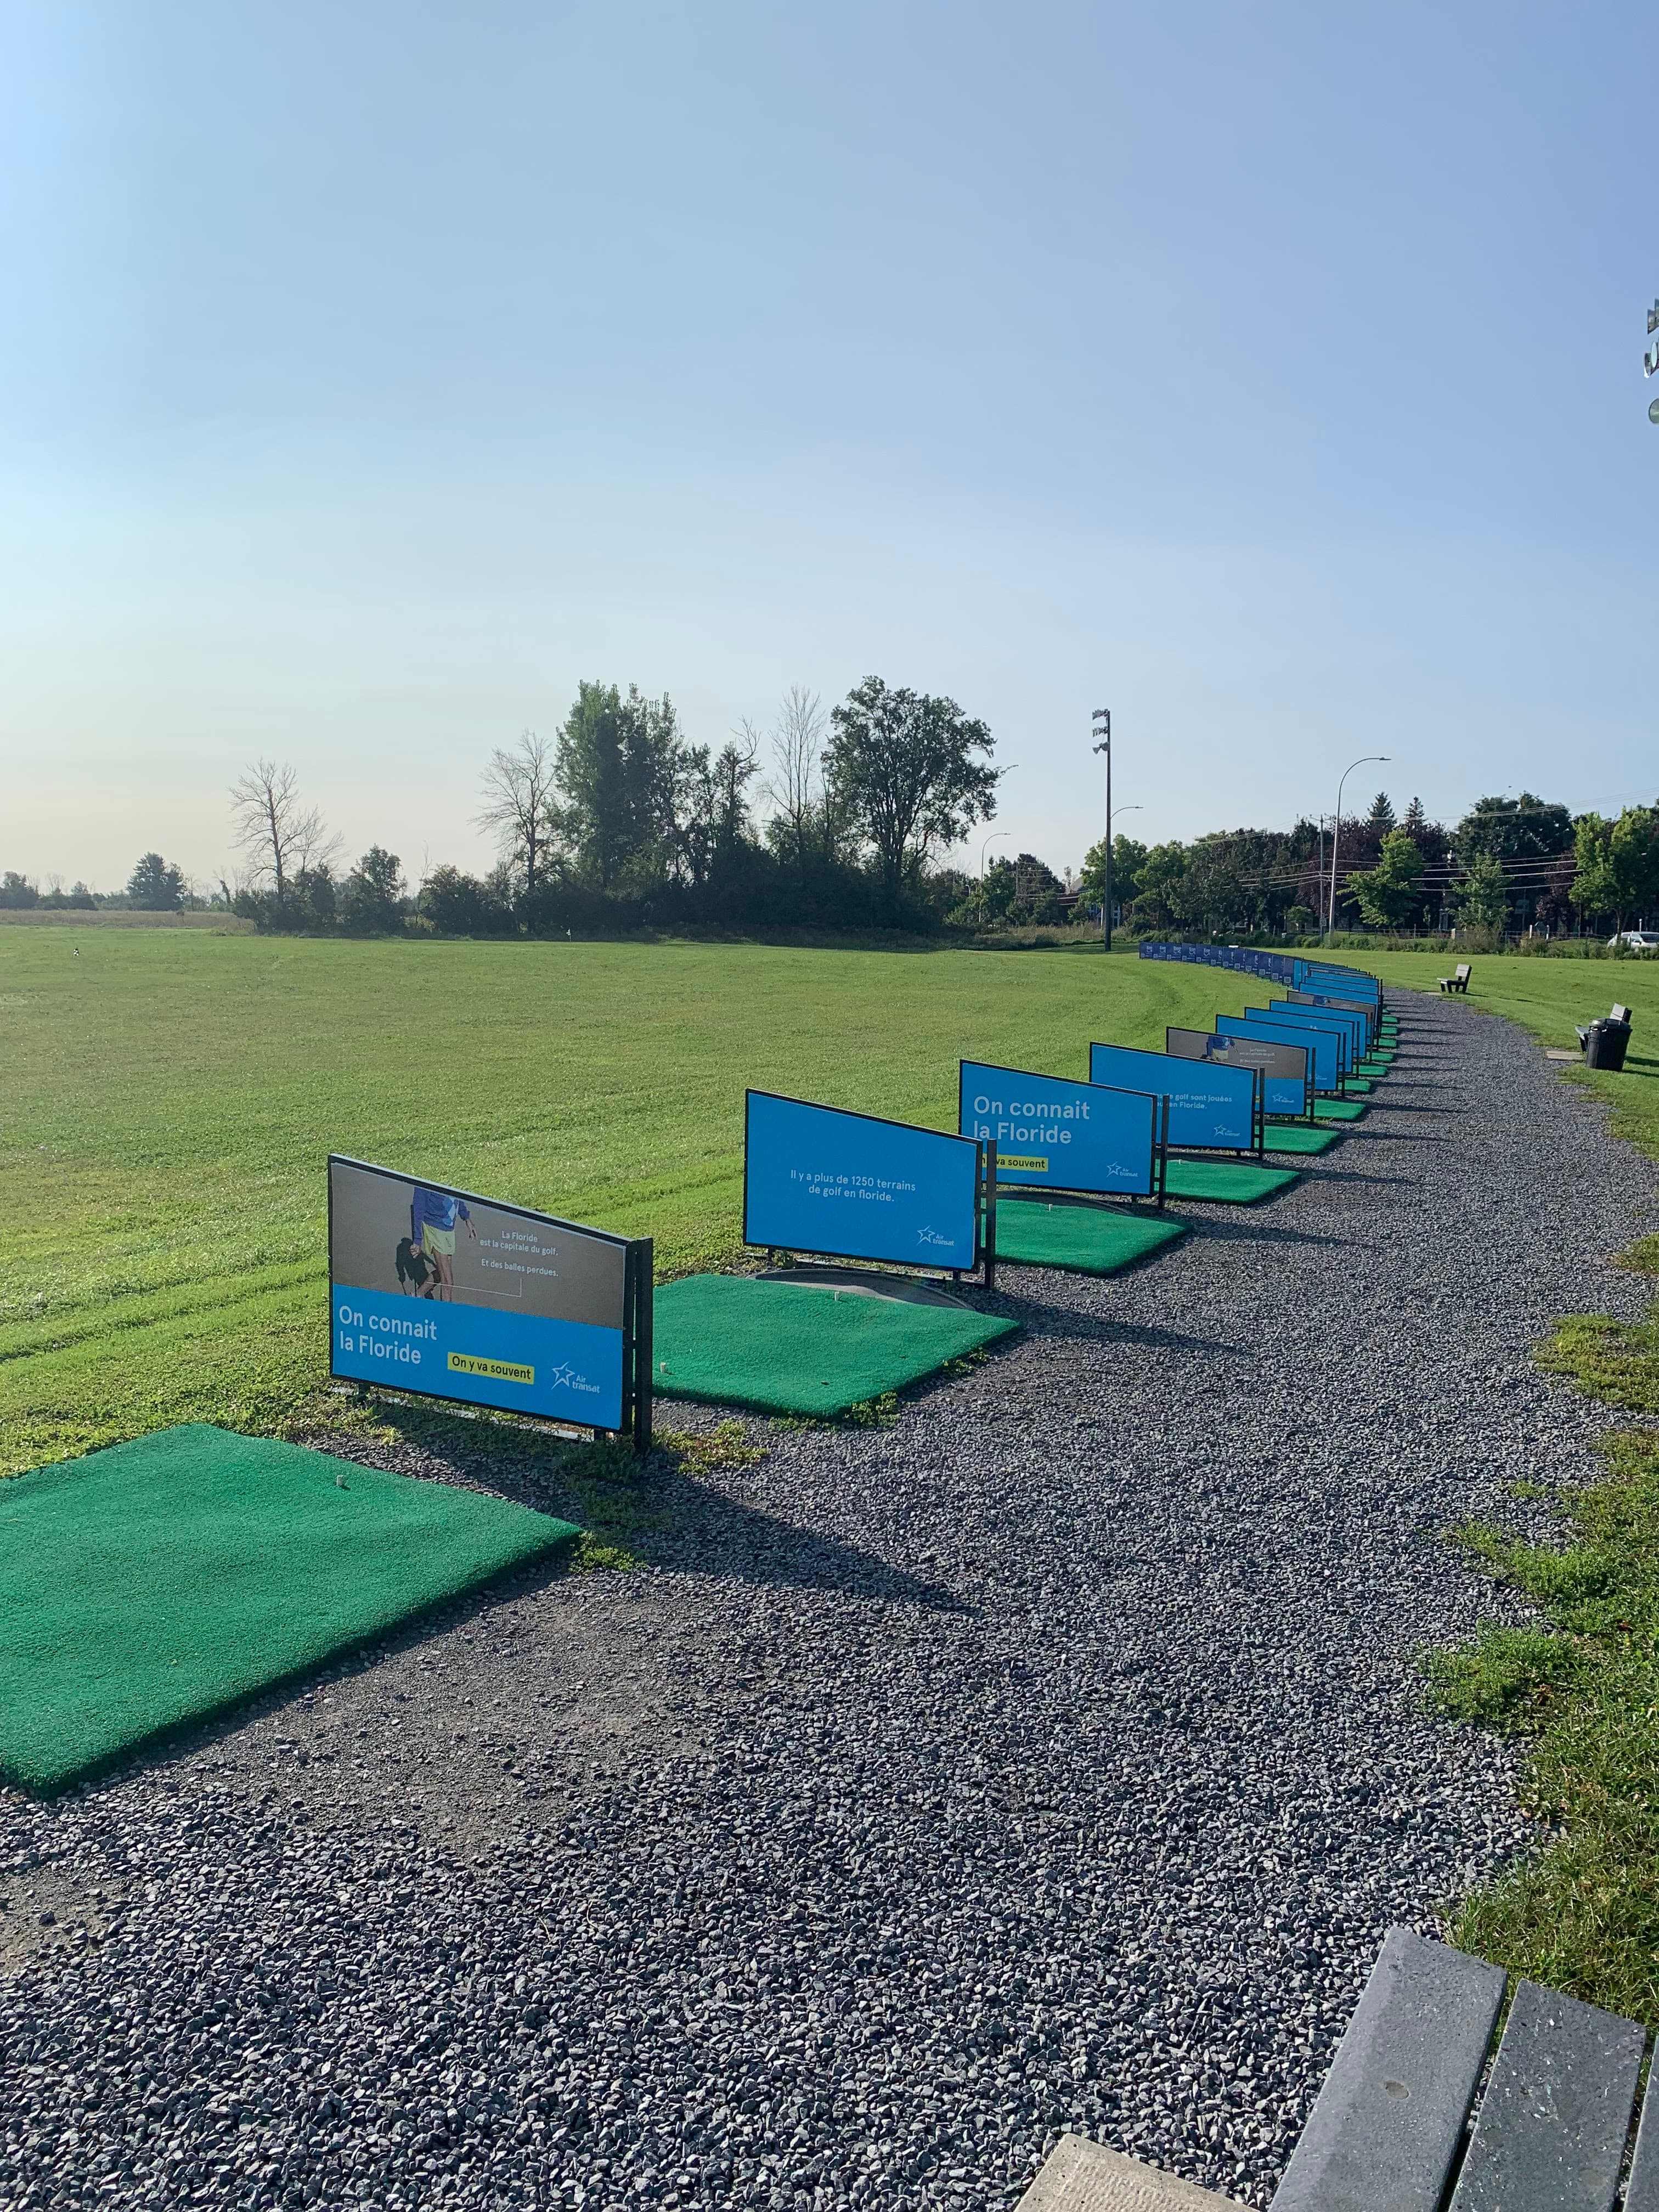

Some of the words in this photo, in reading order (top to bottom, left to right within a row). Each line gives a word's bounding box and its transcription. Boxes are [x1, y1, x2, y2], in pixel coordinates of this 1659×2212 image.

[1175, 1093, 1188, 1101] golf
[974, 1096, 1002, 1115] On
[1009, 1100, 1090, 1120] connait
[974, 1120, 990, 1139] la
[998, 1122, 1071, 1144] Floride
[1008, 1159, 1045, 1169] souvent
[791, 1169, 796, 1179] Il
[799, 1172, 804, 1182] y
[814, 1172, 834, 1184] plus
[837, 1175, 849, 1184] de
[851, 1176, 874, 1187] 1250
[877, 1178, 916, 1191] terrains
[809, 1184, 821, 1194] de
[823, 1187, 842, 1198] golf
[844, 1189, 856, 1198] en
[859, 1189, 895, 1202] floride.
[501, 1231, 510, 1239] La
[512, 1232, 538, 1243] Floride
[480, 1239, 491, 1247] est
[493, 1239, 499, 1248] la
[500, 1242, 529, 1251] capitale
[542, 1247, 558, 1256] golf.
[490, 1260, 503, 1269] des
[504, 1262, 525, 1272] balles
[527, 1266, 559, 1277] perdues.
[339, 1305, 363, 1327] On
[369, 1315, 437, 1340] connait
[340, 1330, 354, 1352] la
[359, 1334, 421, 1364] Floride
[452, 1356, 466, 1368] On
[469, 1361, 476, 1372] y
[477, 1362, 488, 1372] va
[490, 1364, 531, 1380] souvent
[572, 1381, 600, 1394] transat
